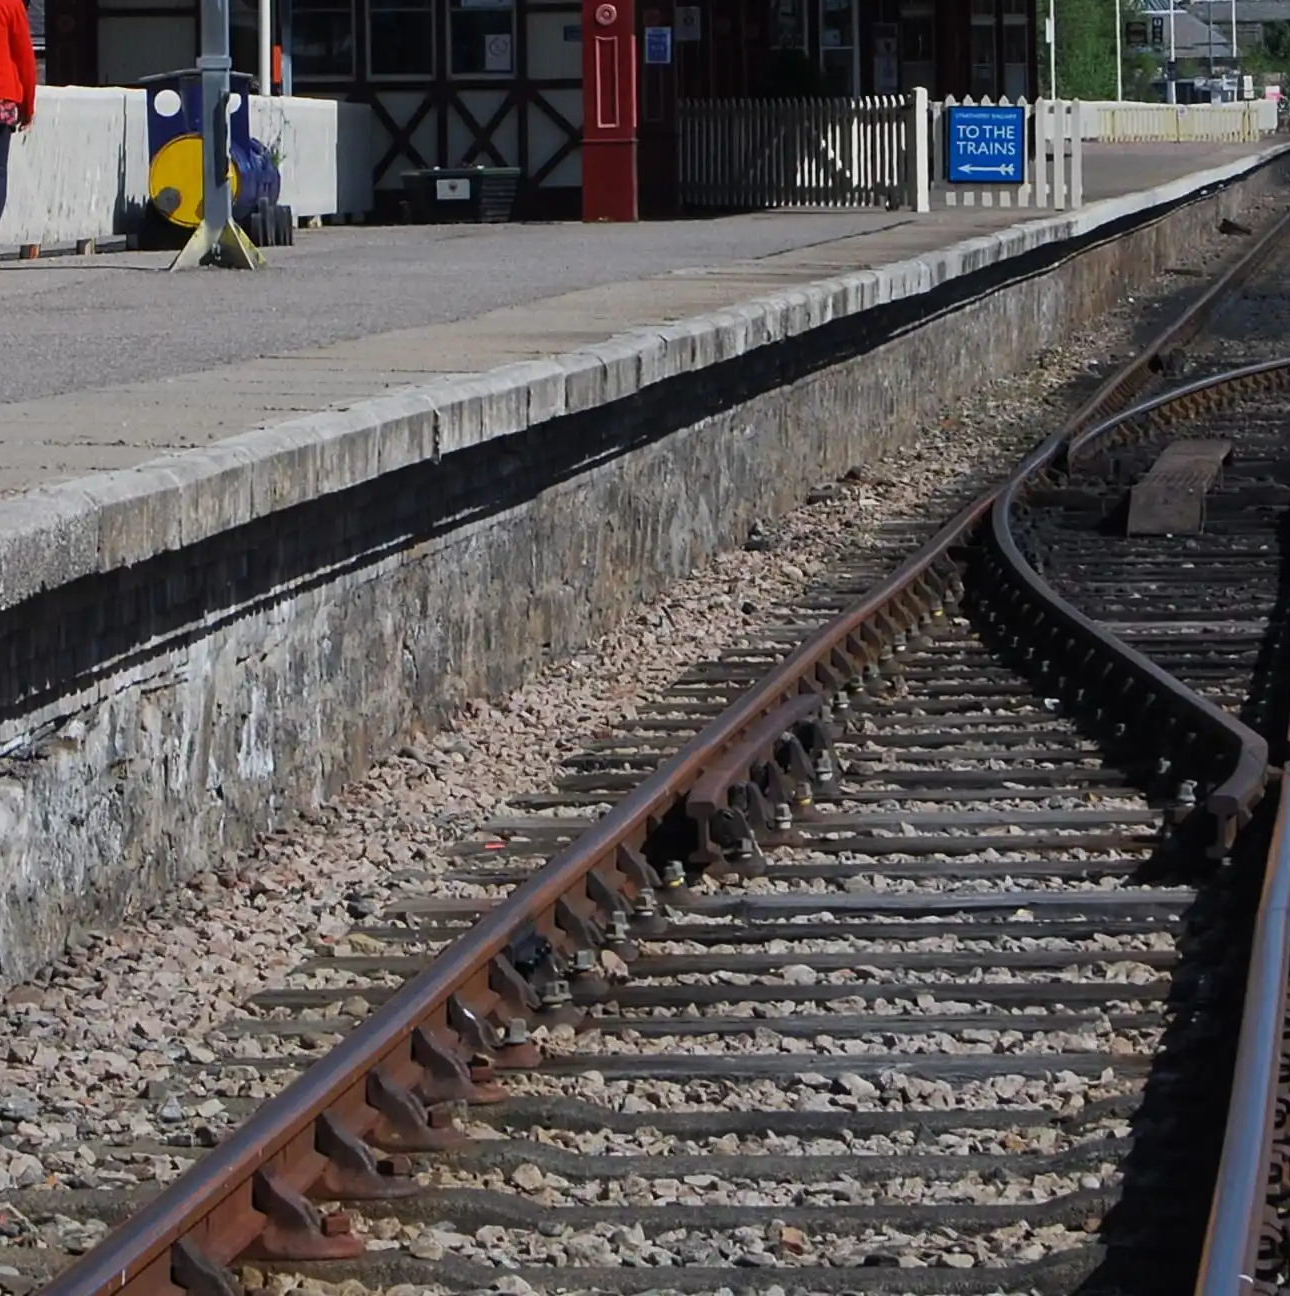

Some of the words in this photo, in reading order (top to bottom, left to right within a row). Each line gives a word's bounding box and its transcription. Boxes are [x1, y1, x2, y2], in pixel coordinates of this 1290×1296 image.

[956, 124, 980, 139] TO
[982, 124, 1016, 139] THE
[956, 141, 1016, 156] TRAINS
